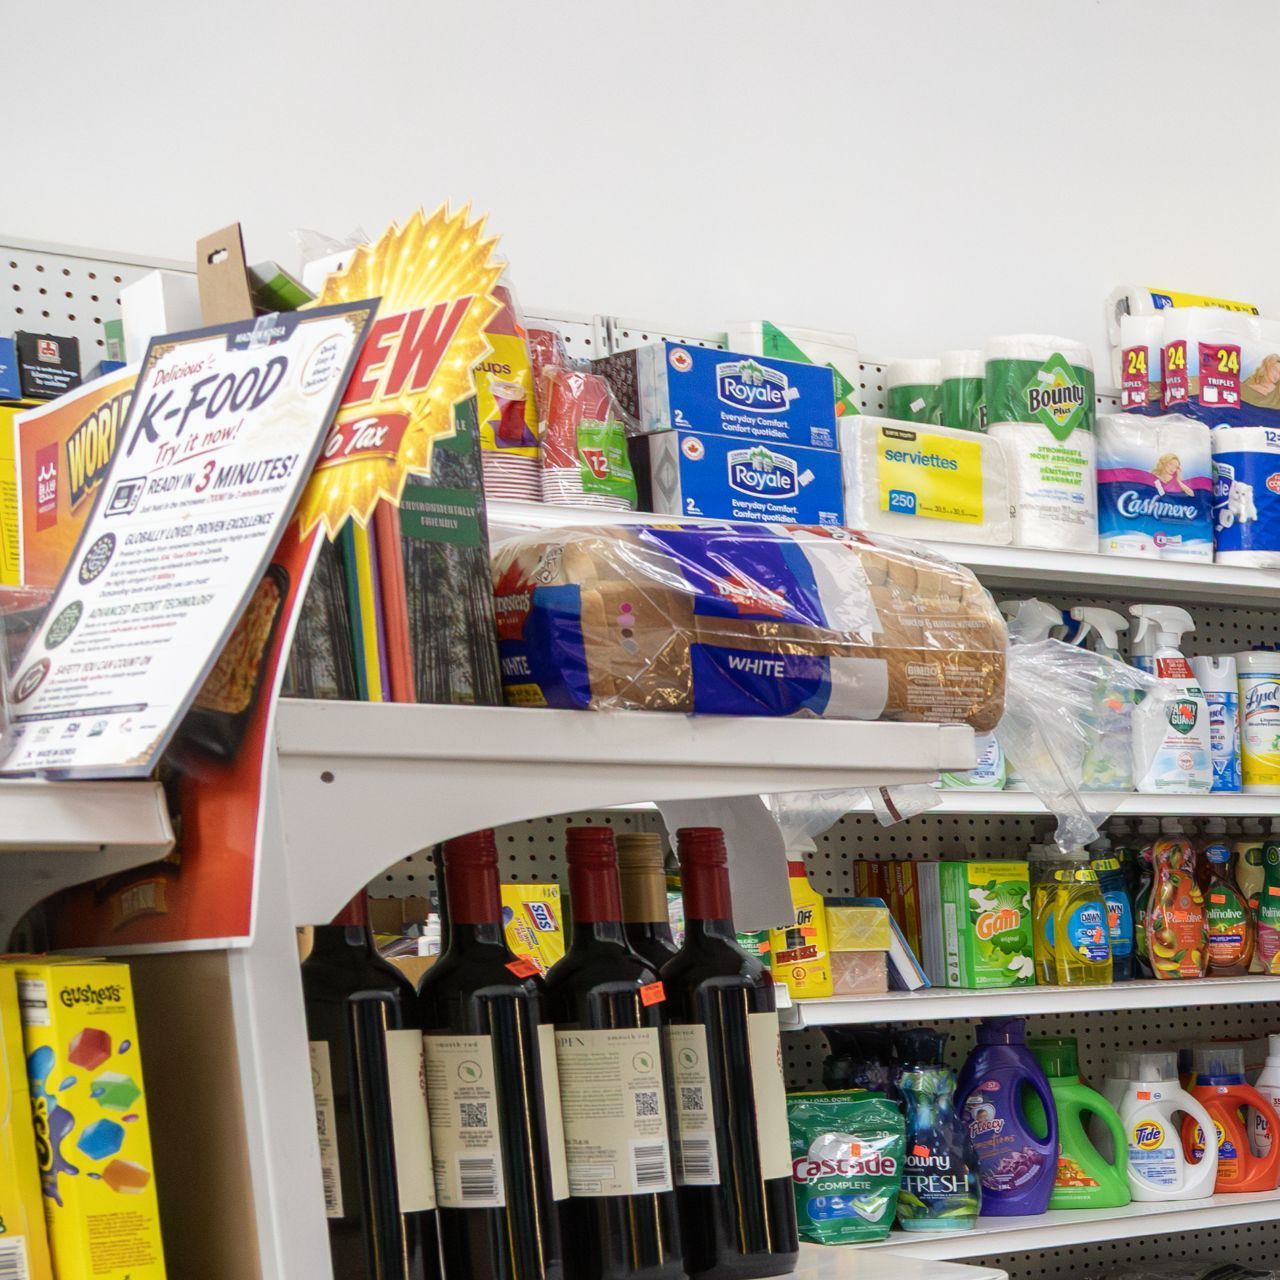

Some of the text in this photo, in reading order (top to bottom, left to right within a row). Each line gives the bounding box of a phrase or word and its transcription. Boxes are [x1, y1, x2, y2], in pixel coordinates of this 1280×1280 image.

[1218, 349, 1239, 373] 24
[153, 361, 205, 389] Delicious
[1208, 377, 1234, 387] TRIPLES
[724, 379, 781, 404] Royale
[1027, 384, 1085, 415] Bounty
[126, 356, 288, 456] K-FOOD
[720, 412, 756, 426] Everyday
[722, 423, 751, 435] Confort
[156, 418, 244, 464] Try it now!
[346, 417, 389, 455] Tax
[885, 448, 958, 472] serviettes
[147, 454, 299, 496] READY IN 3 MINUTES!
[735, 465, 791, 490] Royale
[891, 492, 914, 508] 250
[1117, 488, 1199, 521] Cashmere
[727, 654, 784, 677] WHITE
[1245, 684, 1280, 709] Lysol
[1081, 912, 1101, 922] DAWN
[60, 984, 122, 1008] Gushers
[1135, 1127, 1161, 1141] Tide
[817, 1181, 871, 1191] COMPLETE
